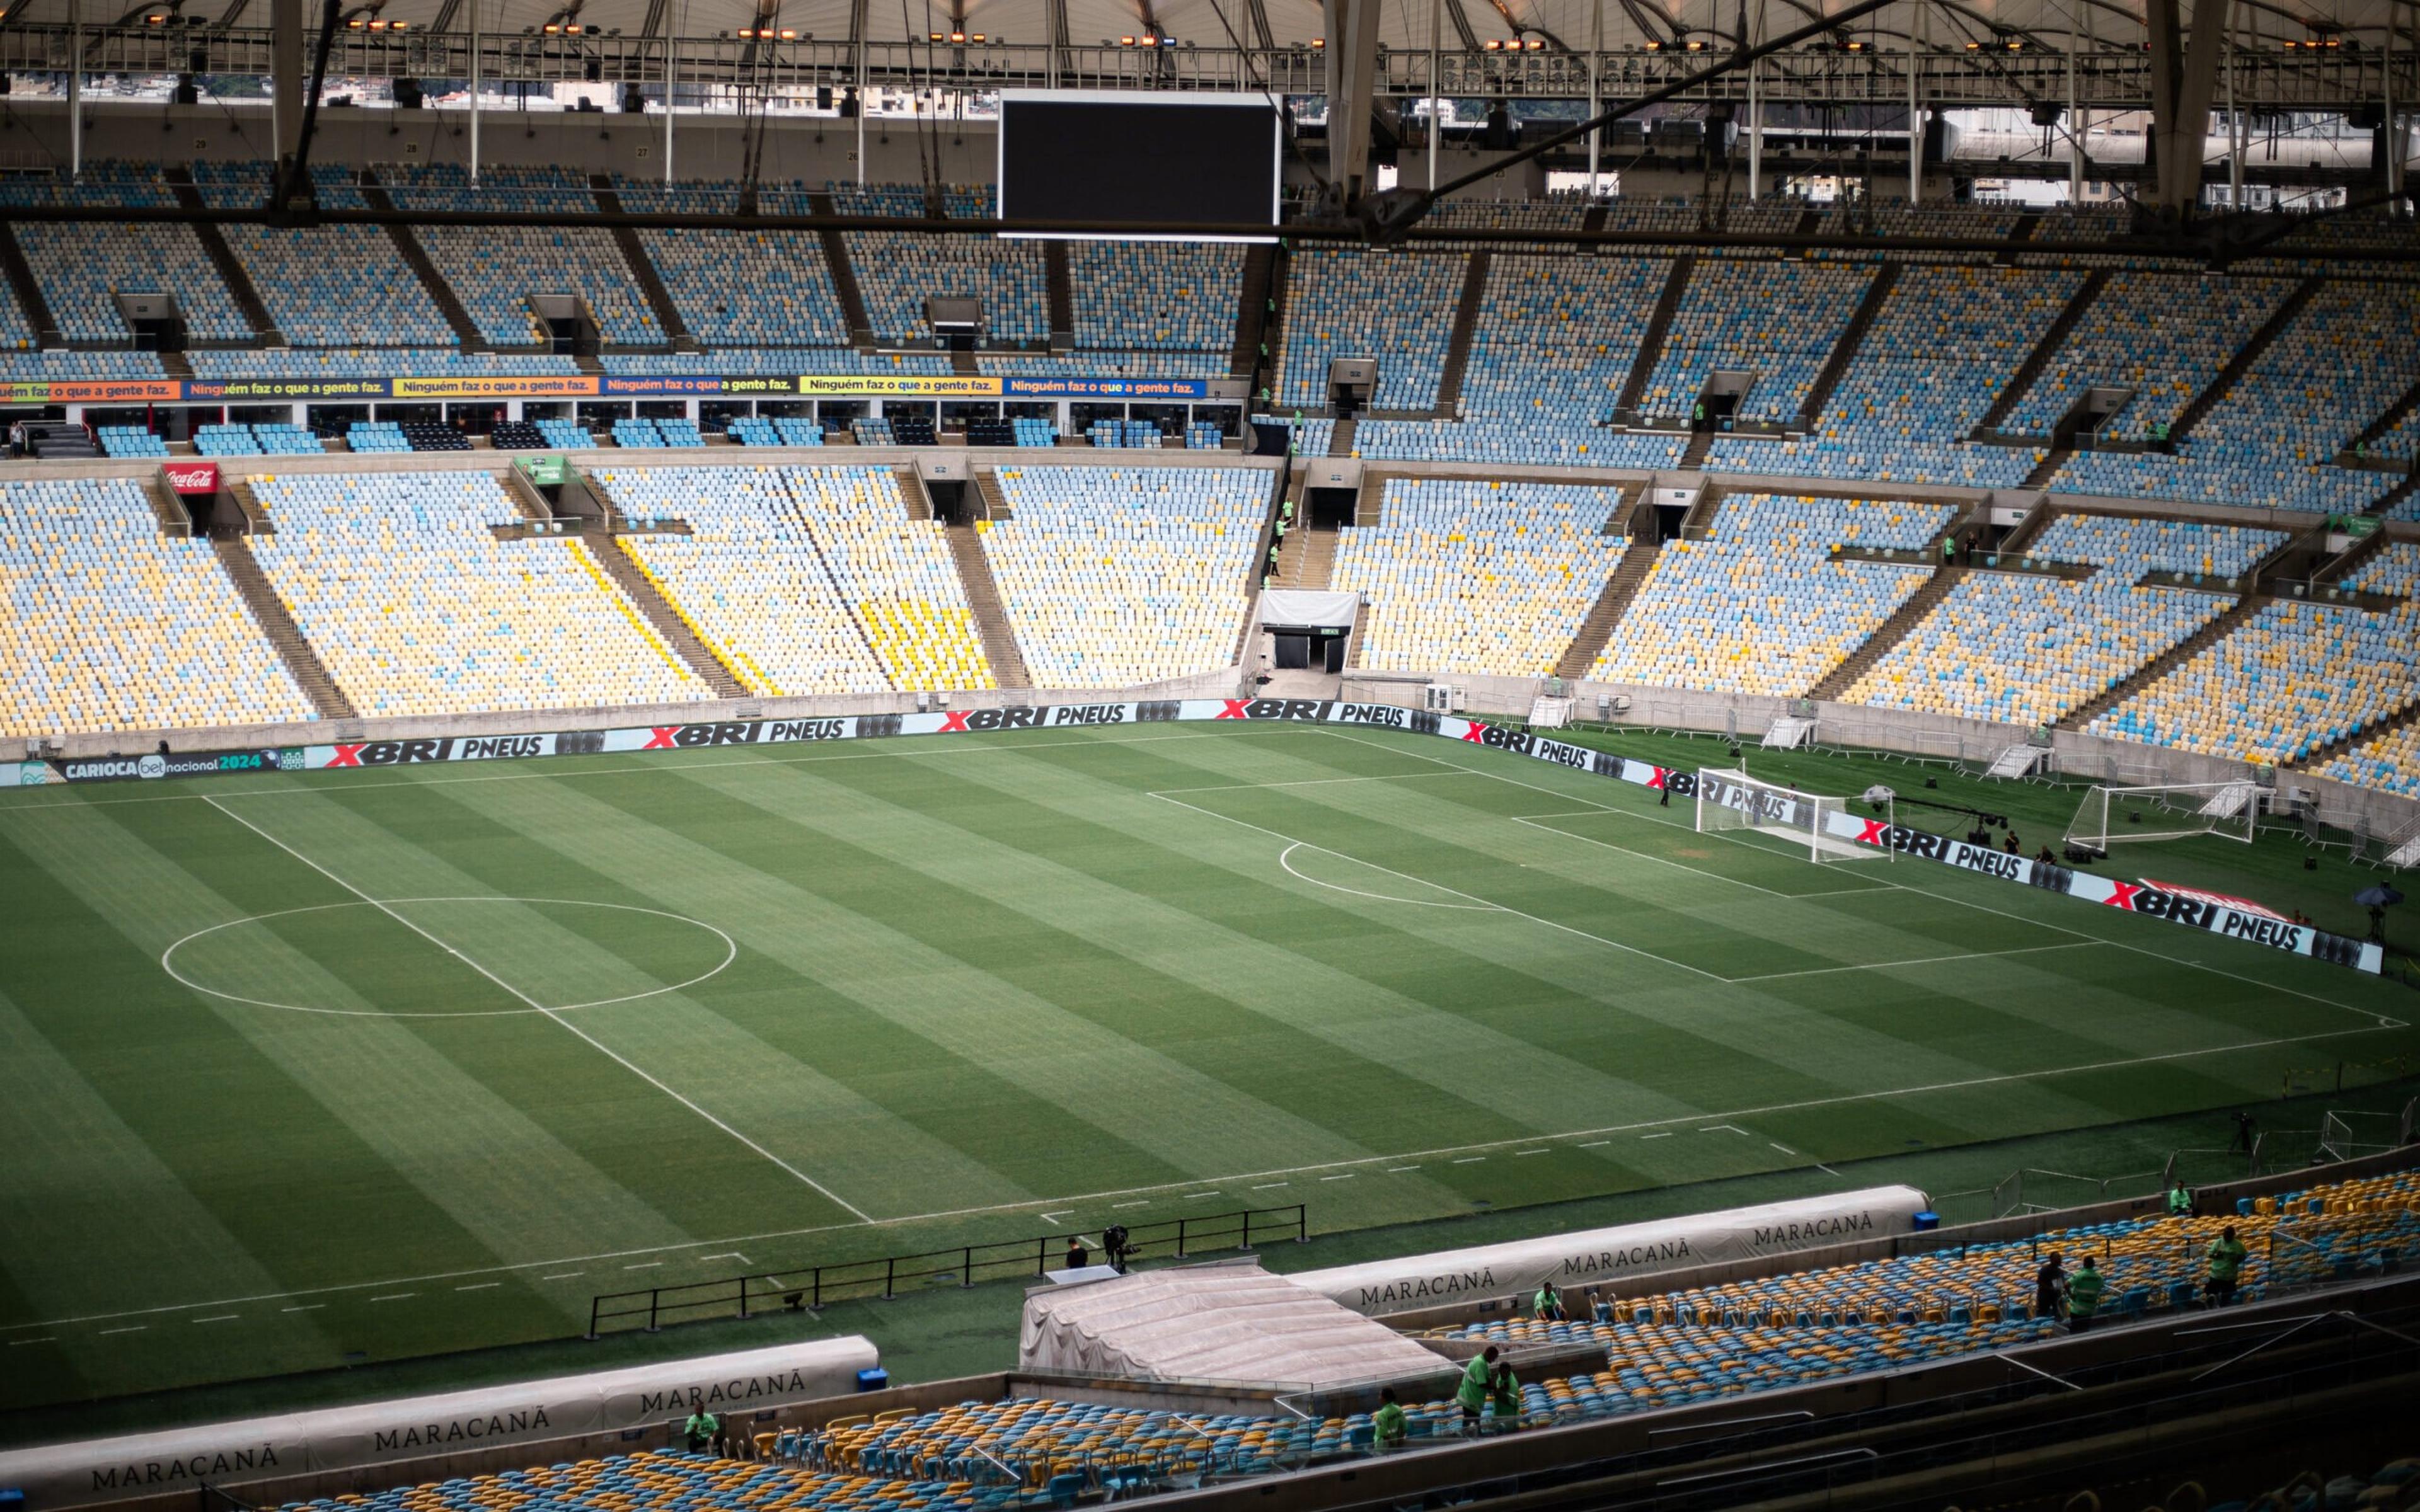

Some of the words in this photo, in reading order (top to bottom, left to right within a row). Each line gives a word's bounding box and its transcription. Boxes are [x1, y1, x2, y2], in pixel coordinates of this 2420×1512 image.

[196, 140, 206, 149] 29
[407, 144, 417, 152] 28
[637, 148, 647, 157] 27
[32, 386, 50, 396] faz
[67, 388, 91, 398] que
[107, 386, 143, 398] gente
[147, 385, 169, 395] faz.
[191, 383, 248, 397] Ninguém
[251, 384, 271, 394] faz
[274, 386, 282, 394] o
[285, 385, 305, 396] que
[313, 385, 320, 393] a
[323, 383, 358, 396] gente
[361, 382, 384, 392] faz.
[403, 382, 458, 393] Ninguém
[462, 382, 479, 391] faz
[494, 383, 516, 393] que
[530, 381, 563, 392] gente
[568, 381, 589, 390] faz.
[608, 379, 662, 391] Ninguém
[665, 379, 682, 389] faz
[696, 382, 718, 391] que
[732, 380, 766, 391] gente
[769, 379, 791, 389] faz.
[810, 379, 863, 391] Ninguém
[867, 379, 884, 389] faz
[898, 382, 920, 391] que
[934, 380, 967, 391] gente
[971, 381, 992, 390] faz.
[1011, 381, 1065, 392] Ninguém
[1068, 381, 1086, 391] faz
[1089, 384, 1097, 392] o
[1100, 384, 1122, 394] que
[1136, 383, 1170, 394] gente
[1173, 383, 1194, 393] faz.
[937, 706, 1049, 731] XBRI
[1055, 704, 1126, 724] PNEUS
[1216, 699, 1334, 719] XBRI
[1339, 704, 1404, 726] PNEUS
[642, 723, 763, 748] XBRI
[769, 719, 845, 741] PNEUS
[1462, 721, 1537, 755] XBRI
[1539, 740, 1587, 769] PNEUS
[323, 739, 454, 767] XBRI
[462, 736, 543, 757] PNEUS
[66, 762, 137, 779] CARIOCA
[219, 754, 262, 769] 2024
[1855, 818, 1952, 862] XBRI
[1956, 845, 2021, 879] PNEUS
[2103, 881, 2220, 929] XBRI
[2222, 911, 2302, 951] PNEUS
[1754, 1211, 1872, 1246] MARACANÃ
[1564, 1238, 1690, 1275] MARACANÃ
[1361, 1267, 1495, 1305] MARACANÃ
[641, 1368, 805, 1412] MARACANÃ
[374, 1405, 550, 1452] MARACANÃ
[92, 1443, 278, 1491] MARACANÃ
